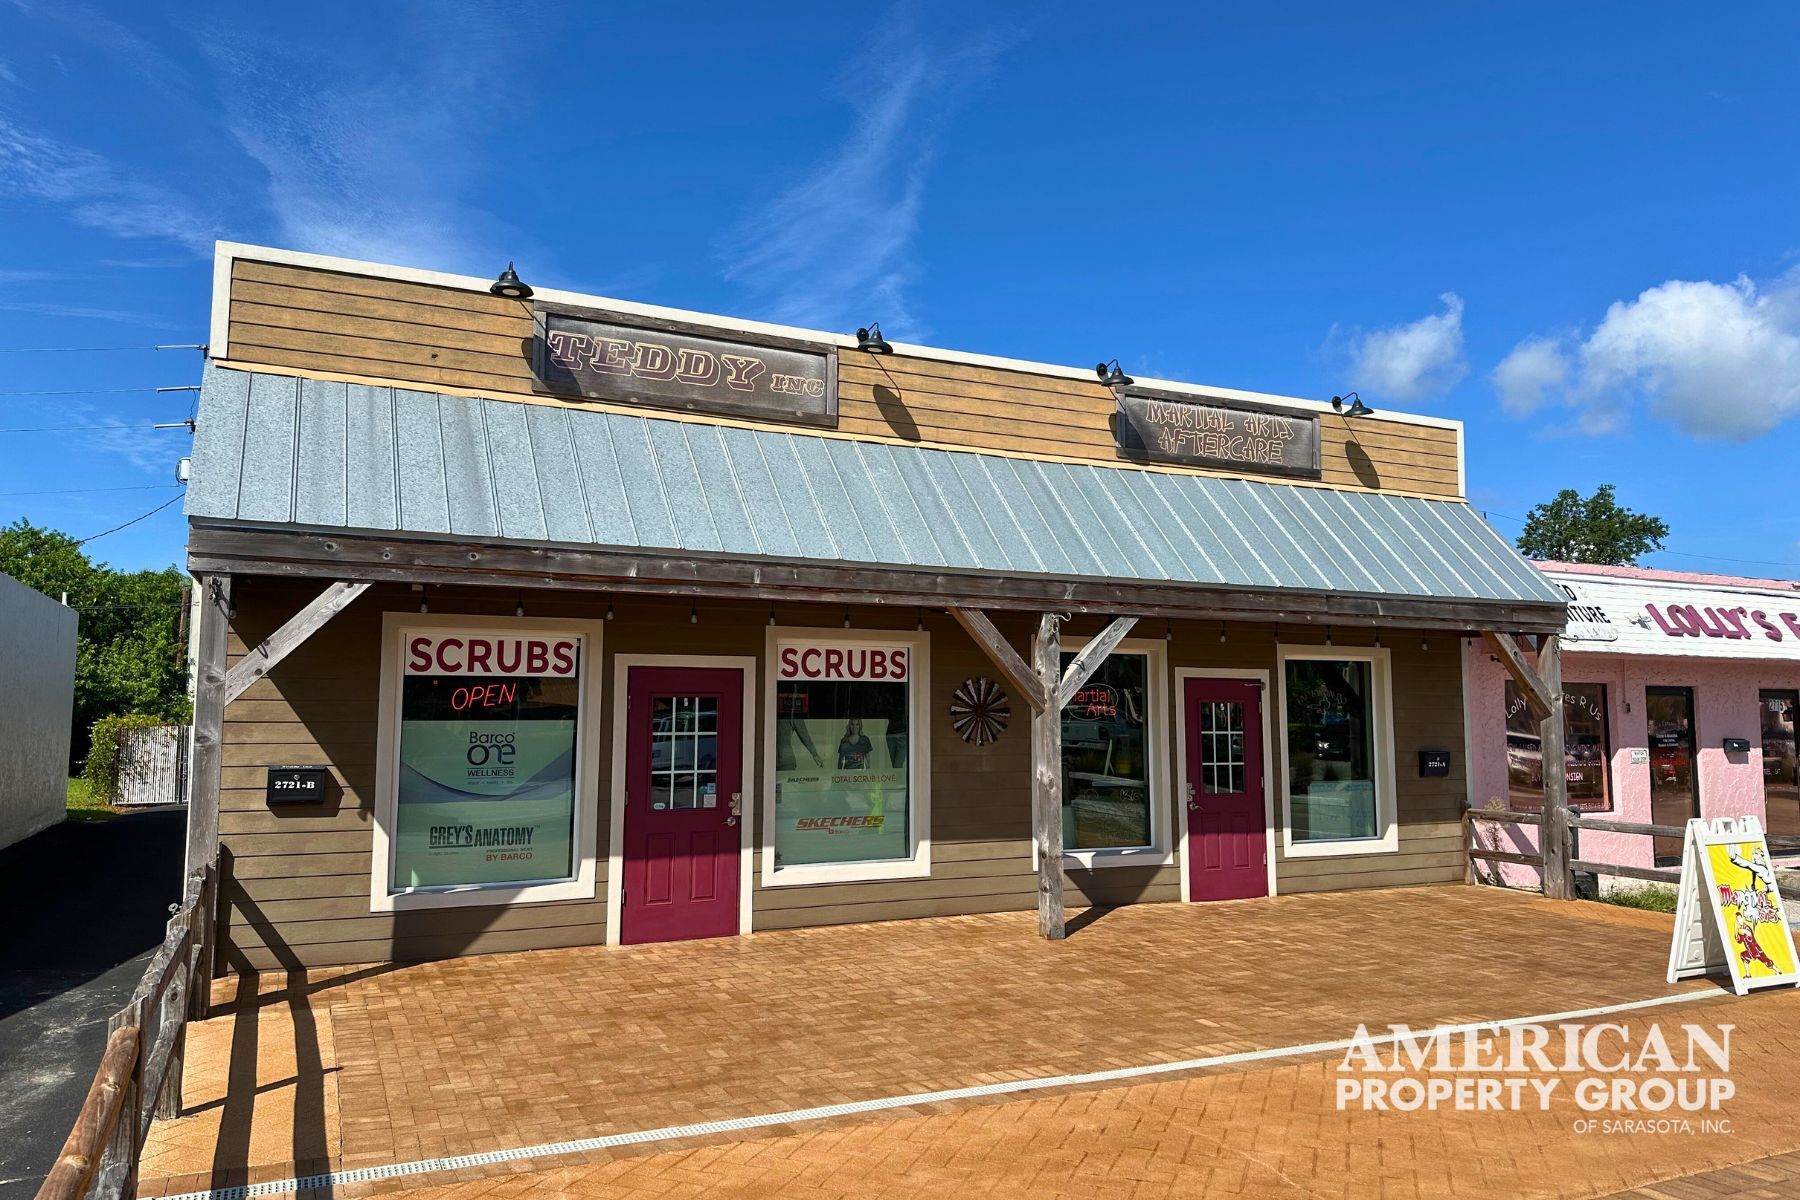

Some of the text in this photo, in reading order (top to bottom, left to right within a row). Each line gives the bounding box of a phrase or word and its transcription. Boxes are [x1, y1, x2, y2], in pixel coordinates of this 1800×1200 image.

[547, 330, 825, 398] TEDDY INC
[1146, 398, 1295, 440] MARTIAL ARTS
[1157, 427, 1283, 464] AFTERCARE
[1567, 605, 1611, 623] ITURE
[1645, 603, 1782, 642] LOLLY'S
[409, 637, 574, 675] SCRUBS
[780, 647, 907, 679] SCRUBS
[451, 682, 517, 711] OPEN
[1073, 689, 1111, 702] artial
[1086, 703, 1117, 717] Arts
[469, 731, 515, 744] Barco
[467, 769, 515, 777] WELLNESS
[831, 774, 897, 784] TOTAL SCRUB LOVE
[1566, 772, 1584, 781] NSIGN
[274, 781, 315, 789] 2721-B
[796, 816, 885, 828] SKECHERS
[429, 825, 534, 847] GREY'S ANATOMY
[500, 852, 533, 861] BARCO
